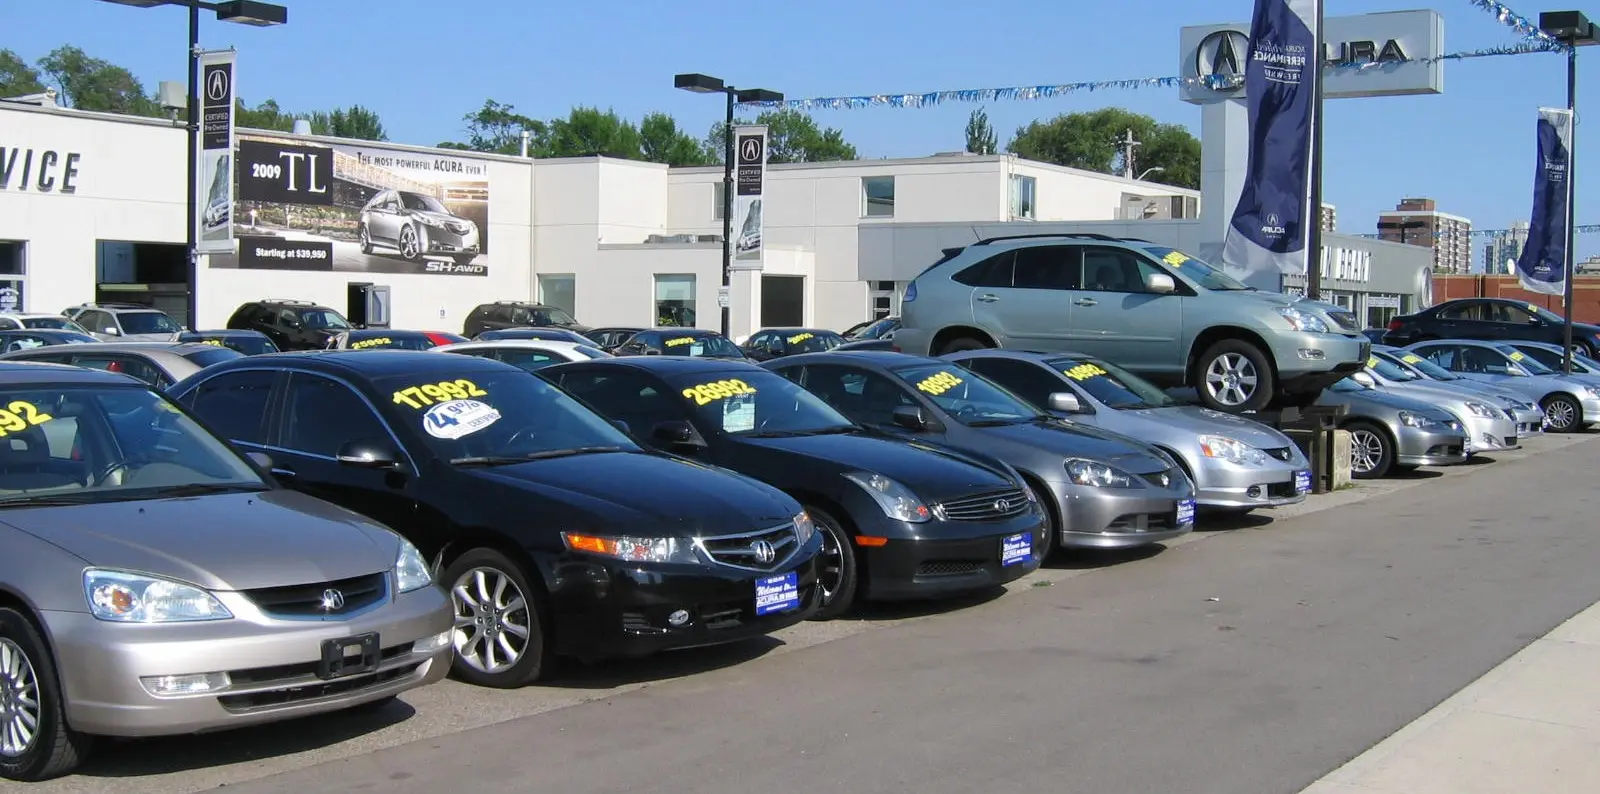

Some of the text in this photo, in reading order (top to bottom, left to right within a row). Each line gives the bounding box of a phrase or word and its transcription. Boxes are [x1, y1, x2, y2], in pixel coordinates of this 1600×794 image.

[1322, 39, 1409, 62] URA
[252, 151, 327, 193] 2009 TL
[374, 157, 393, 167] MOST
[433, 160, 463, 173] ACURA
[255, 243, 286, 259] Starting
[287, 249, 296, 259] at
[425, 260, 484, 273] SH-AWD
[393, 379, 488, 409] 17992
[682, 379, 757, 405] 26992
